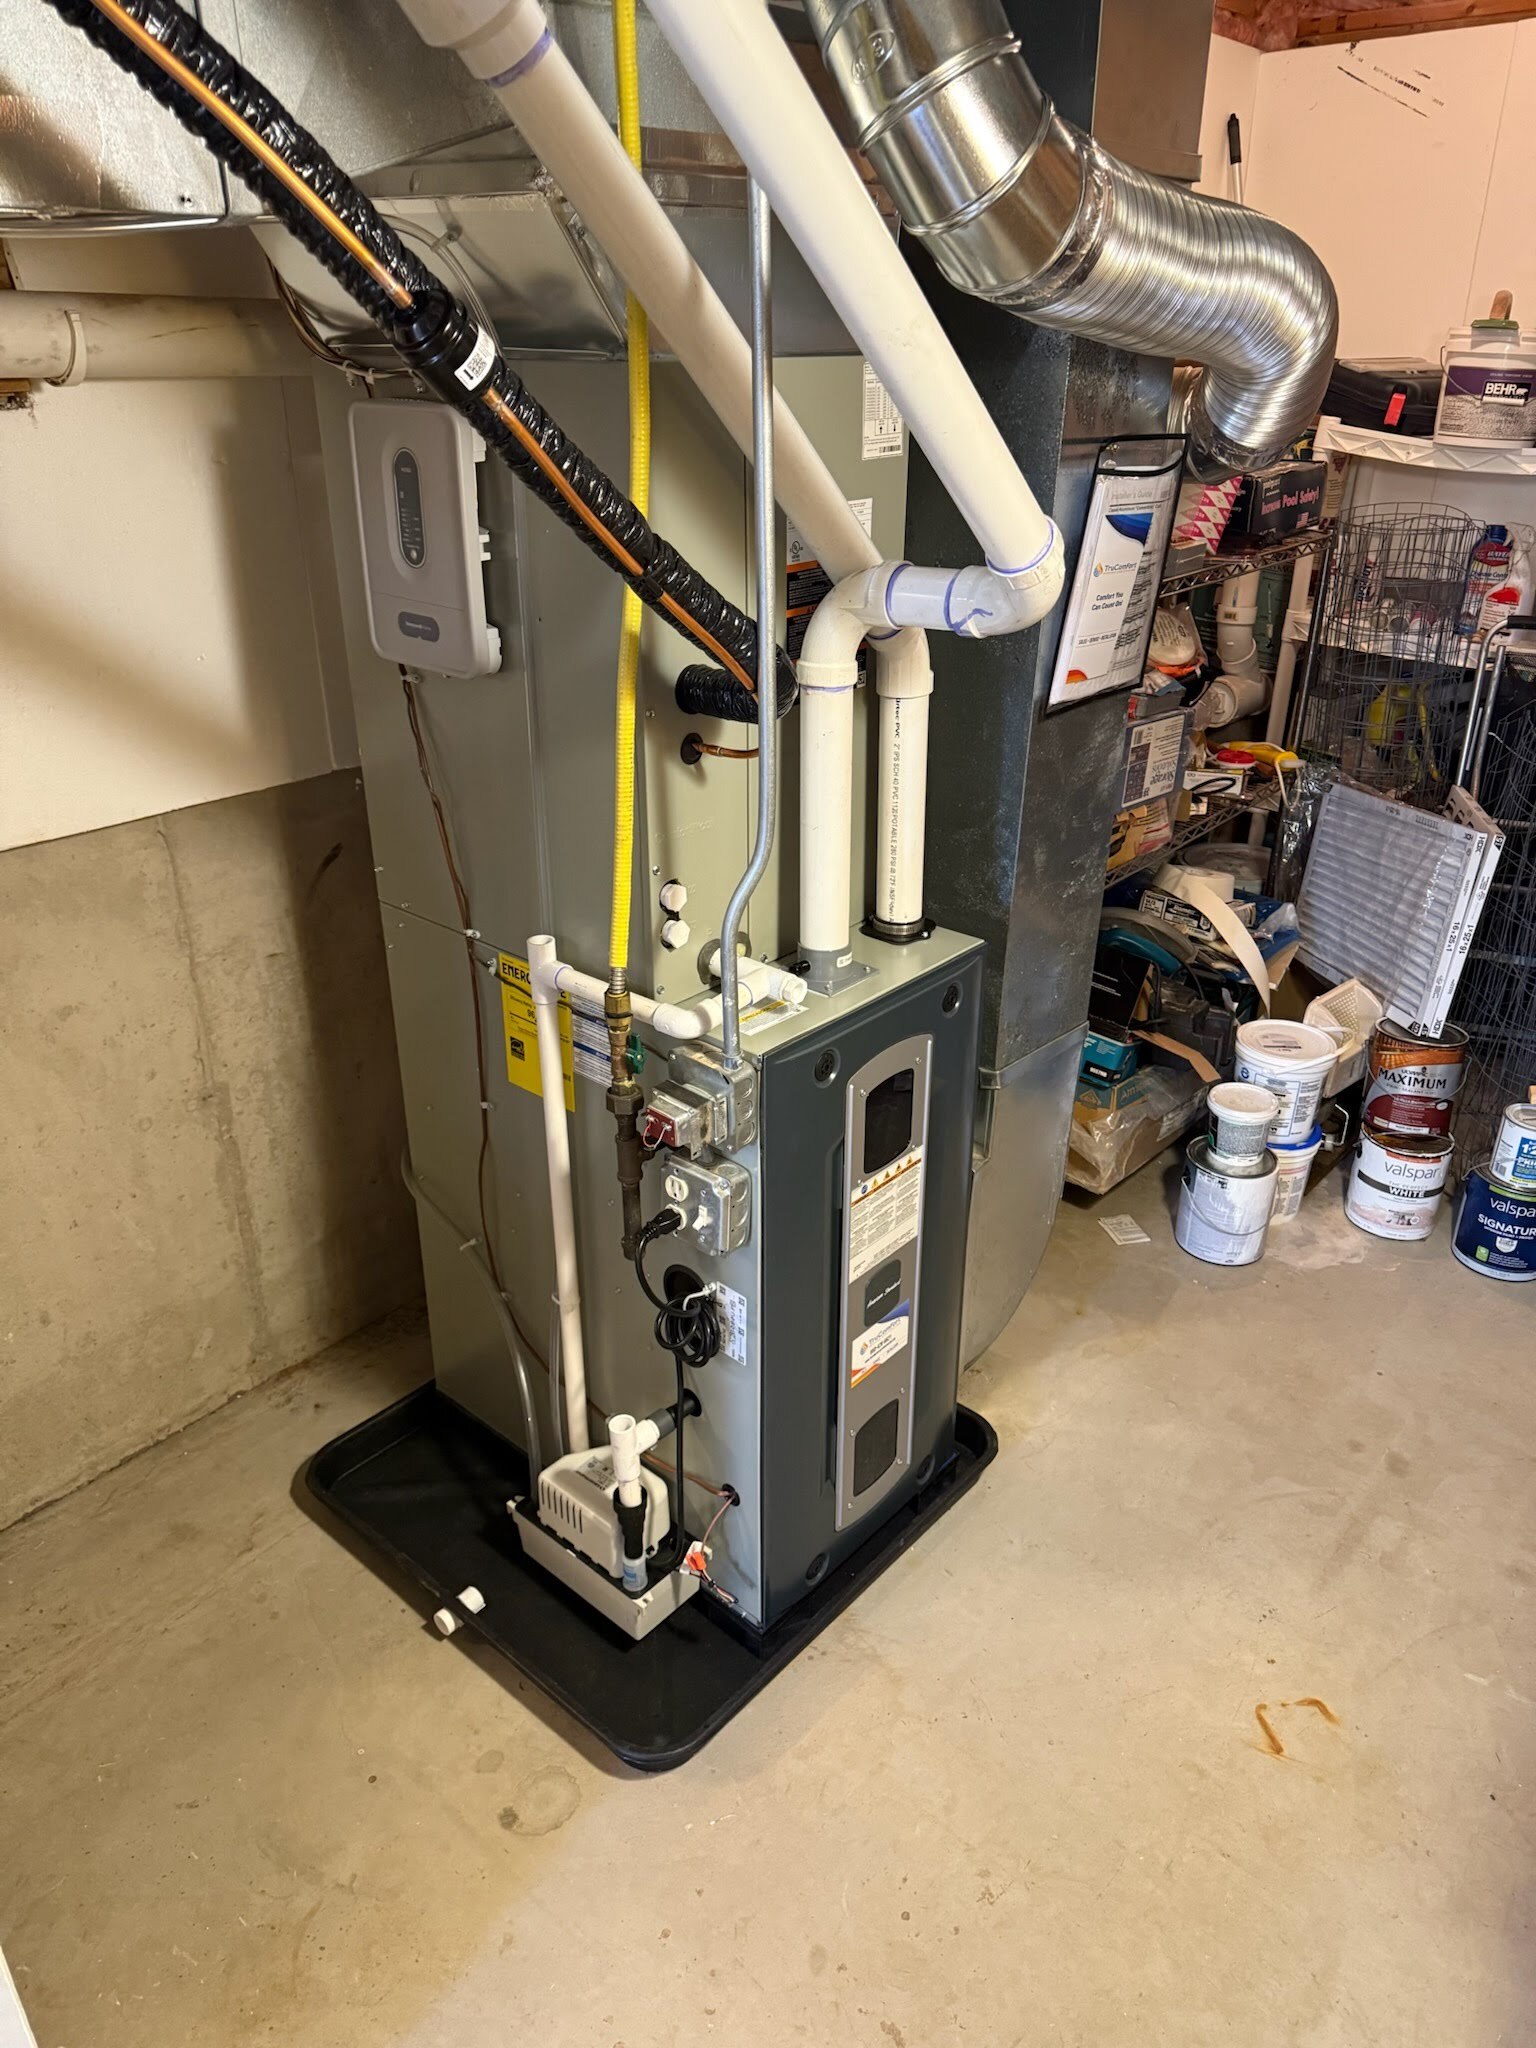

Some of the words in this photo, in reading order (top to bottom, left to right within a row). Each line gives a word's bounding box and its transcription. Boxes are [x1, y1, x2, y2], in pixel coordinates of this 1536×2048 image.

[1485, 382, 1517, 395] BEHR
[1282, 491, 1299, 508] Pool
[1300, 486, 1320, 504] Safety!
[1104, 562, 1137, 572] TruComfort
[1096, 593, 1115, 601] Comfort
[1091, 603, 1101, 611] Can
[1101, 602, 1115, 610] Count
[1149, 770, 1175, 786] Storage
[890, 814, 899, 843] POTABLE
[1432, 1019, 1444, 1035] HDX
[1379, 1067, 1447, 1089] MAXIMUM
[1384, 1161, 1439, 1181] valspar
[1389, 1186, 1425, 1198] WHITE
